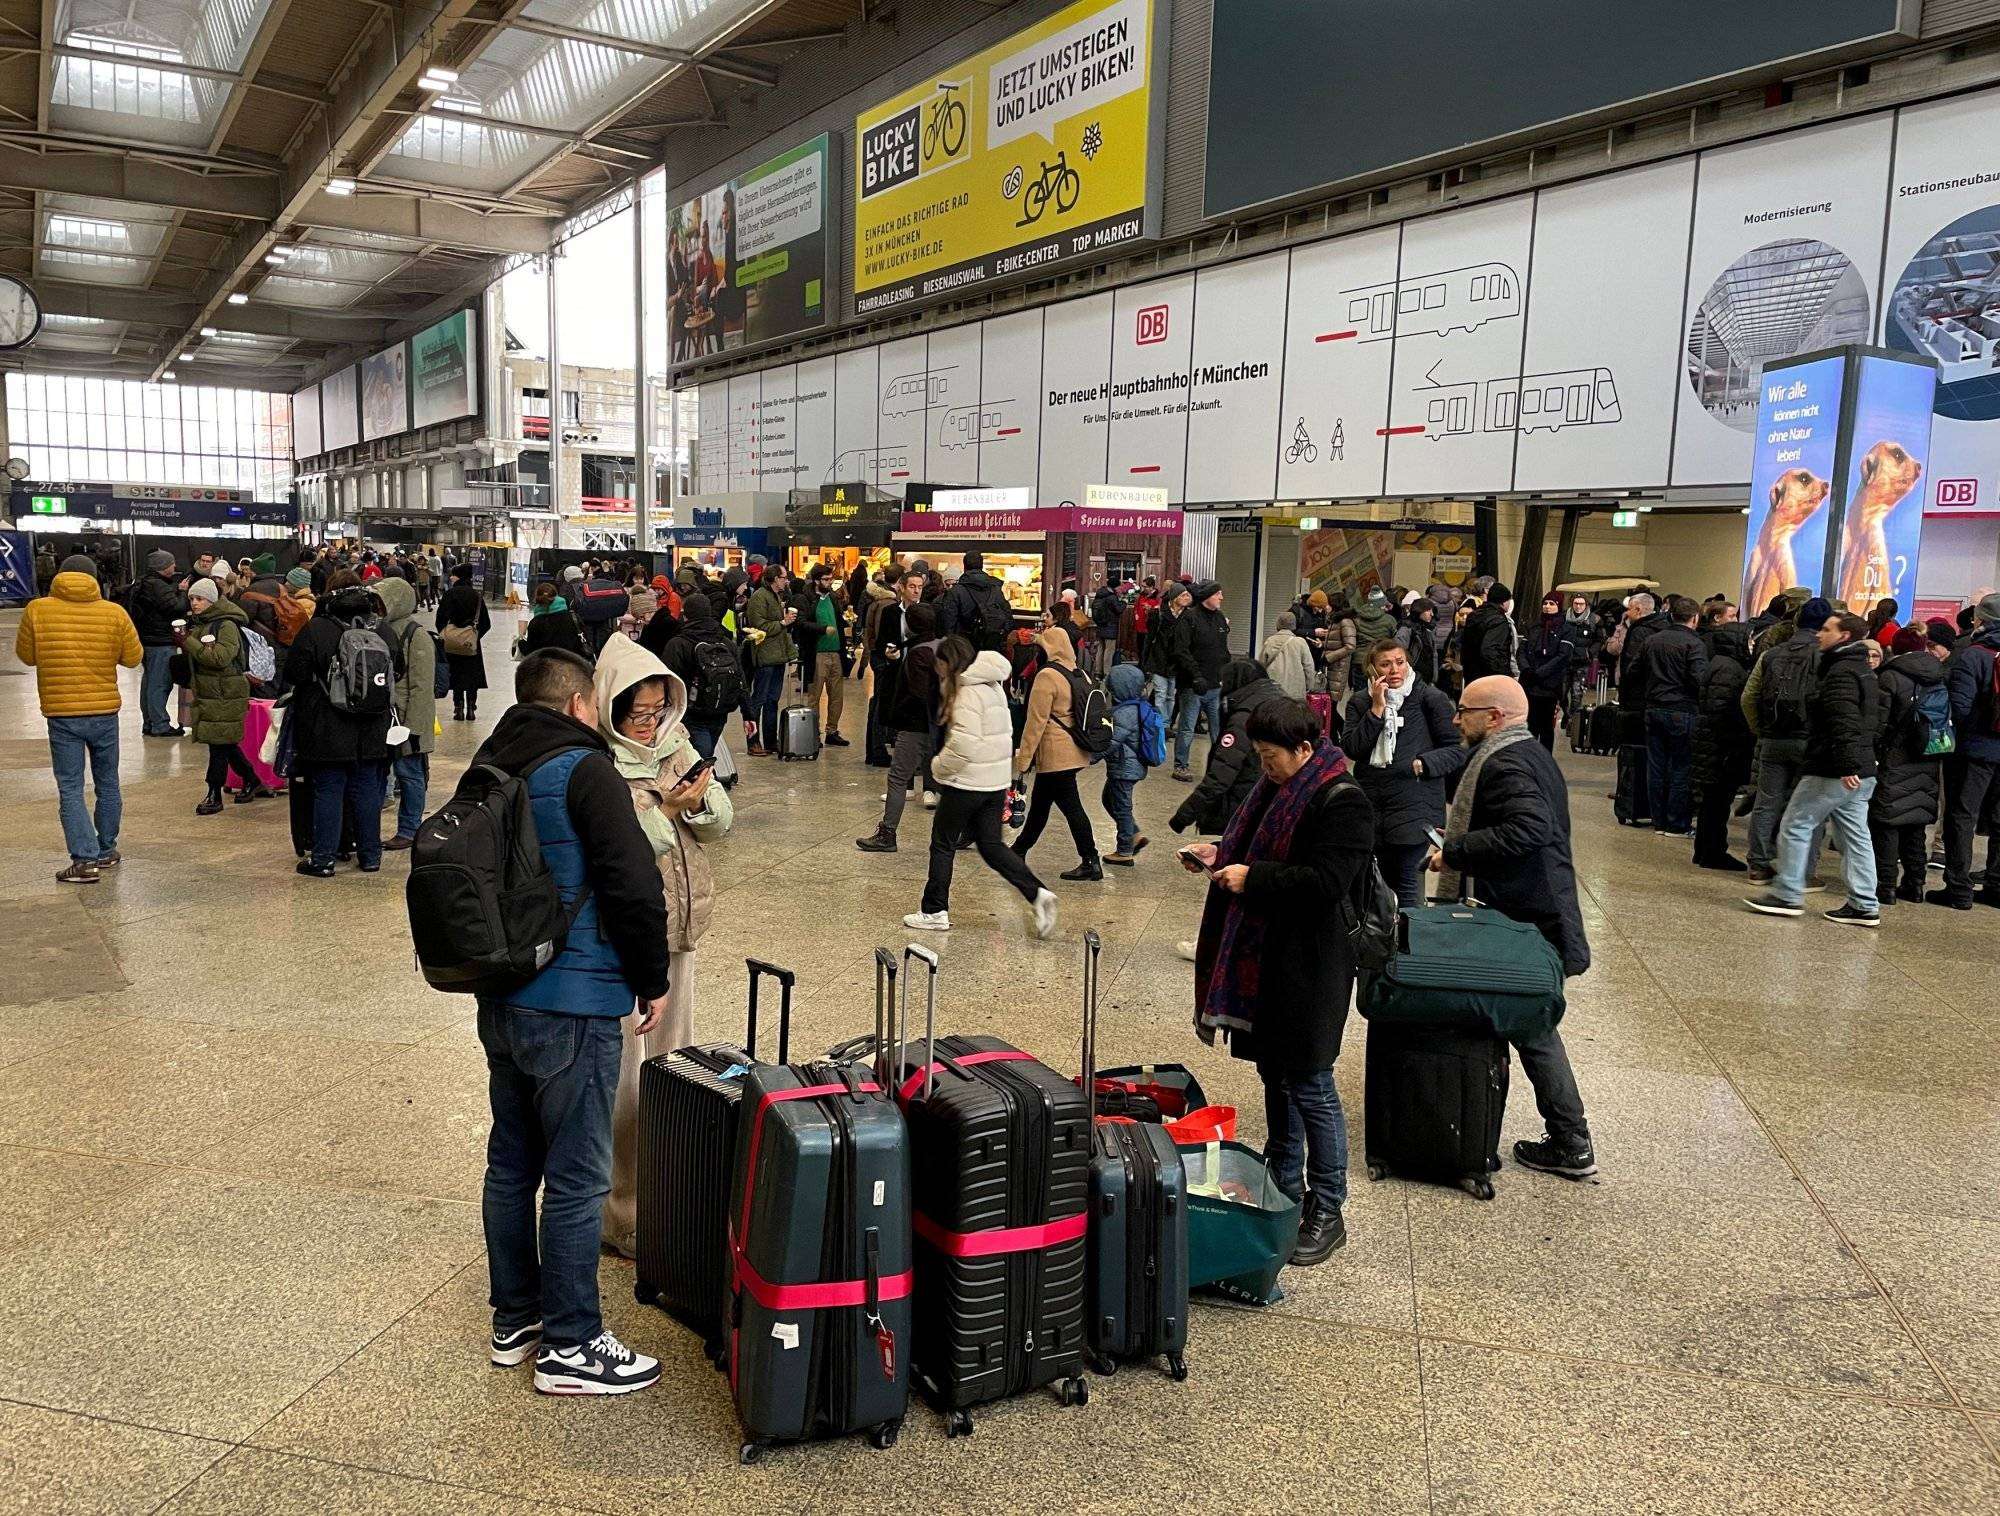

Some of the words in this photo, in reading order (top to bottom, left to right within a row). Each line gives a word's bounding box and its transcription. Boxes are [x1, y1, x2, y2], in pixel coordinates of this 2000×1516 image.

[997, 62, 1036, 100] JETZT
[1040, 18, 1128, 80] UMSTEIGEN
[996, 96, 1025, 128] UND
[1029, 72, 1077, 114] LUCKY
[1081, 45, 1135, 92] BIKEN!
[866, 118, 916, 160] LUCKY
[865, 144, 915, 188] BIKE
[1899, 172, 2000, 198] Stationsneubau
[865, 220, 895, 242] EINFACH
[896, 215, 912, 230] DAS
[913, 199, 950, 224] RICHTIGE
[952, 192, 969, 210] RAD
[1744, 201, 1832, 225] Modernisierung
[864, 246, 874, 259] 3X
[875, 242, 883, 255] IN
[885, 228, 921, 252] MÜNCHEN
[858, 285, 914, 313] FAHRRADLEASING
[923, 265, 986, 294] RIESENAUSWAHL
[996, 243, 1059, 275] E-BIKE-CENTER
[1072, 234, 1091, 253] TOP
[1095, 219, 1139, 247] MARKEN
[864, 240, 944, 276] WWW.LUCKY-BIKE.DE
[1139, 310, 1166, 340] DB
[1049, 390, 1068, 406] Der
[1070, 386, 1098, 404] neue
[1202, 360, 1269, 386] München
[1768, 385, 1786, 403] Wir
[1788, 380, 1807, 400] alle
[1084, 415, 1093, 424] Für
[1094, 414, 1108, 423] Uns.
[1111, 412, 1122, 421] Für
[1122, 409, 1134, 419] die
[1134, 406, 1162, 418] Umwelt.
[1164, 404, 1174, 414] Für
[1176, 403, 1188, 413] die
[1190, 399, 1223, 412] Zukunft.
[1774, 409, 1800, 422] können
[1801, 404, 1820, 418] nicht
[1768, 430, 1788, 444] ohne
[1789, 427, 1812, 440] Natur
[1777, 448, 1801, 462] leben!
[38, 482, 76, 494] 27-36
[1941, 483, 1973, 502] DB
[939, 512, 968, 529] Speisen
[969, 512, 982, 526] und
[984, 512, 1021, 530] Getränke
[1080, 514, 1116, 528] Speisen
[1118, 516, 1134, 527] und
[1136, 516, 1177, 530] Getränke
[1864, 565, 1882, 588] Du
